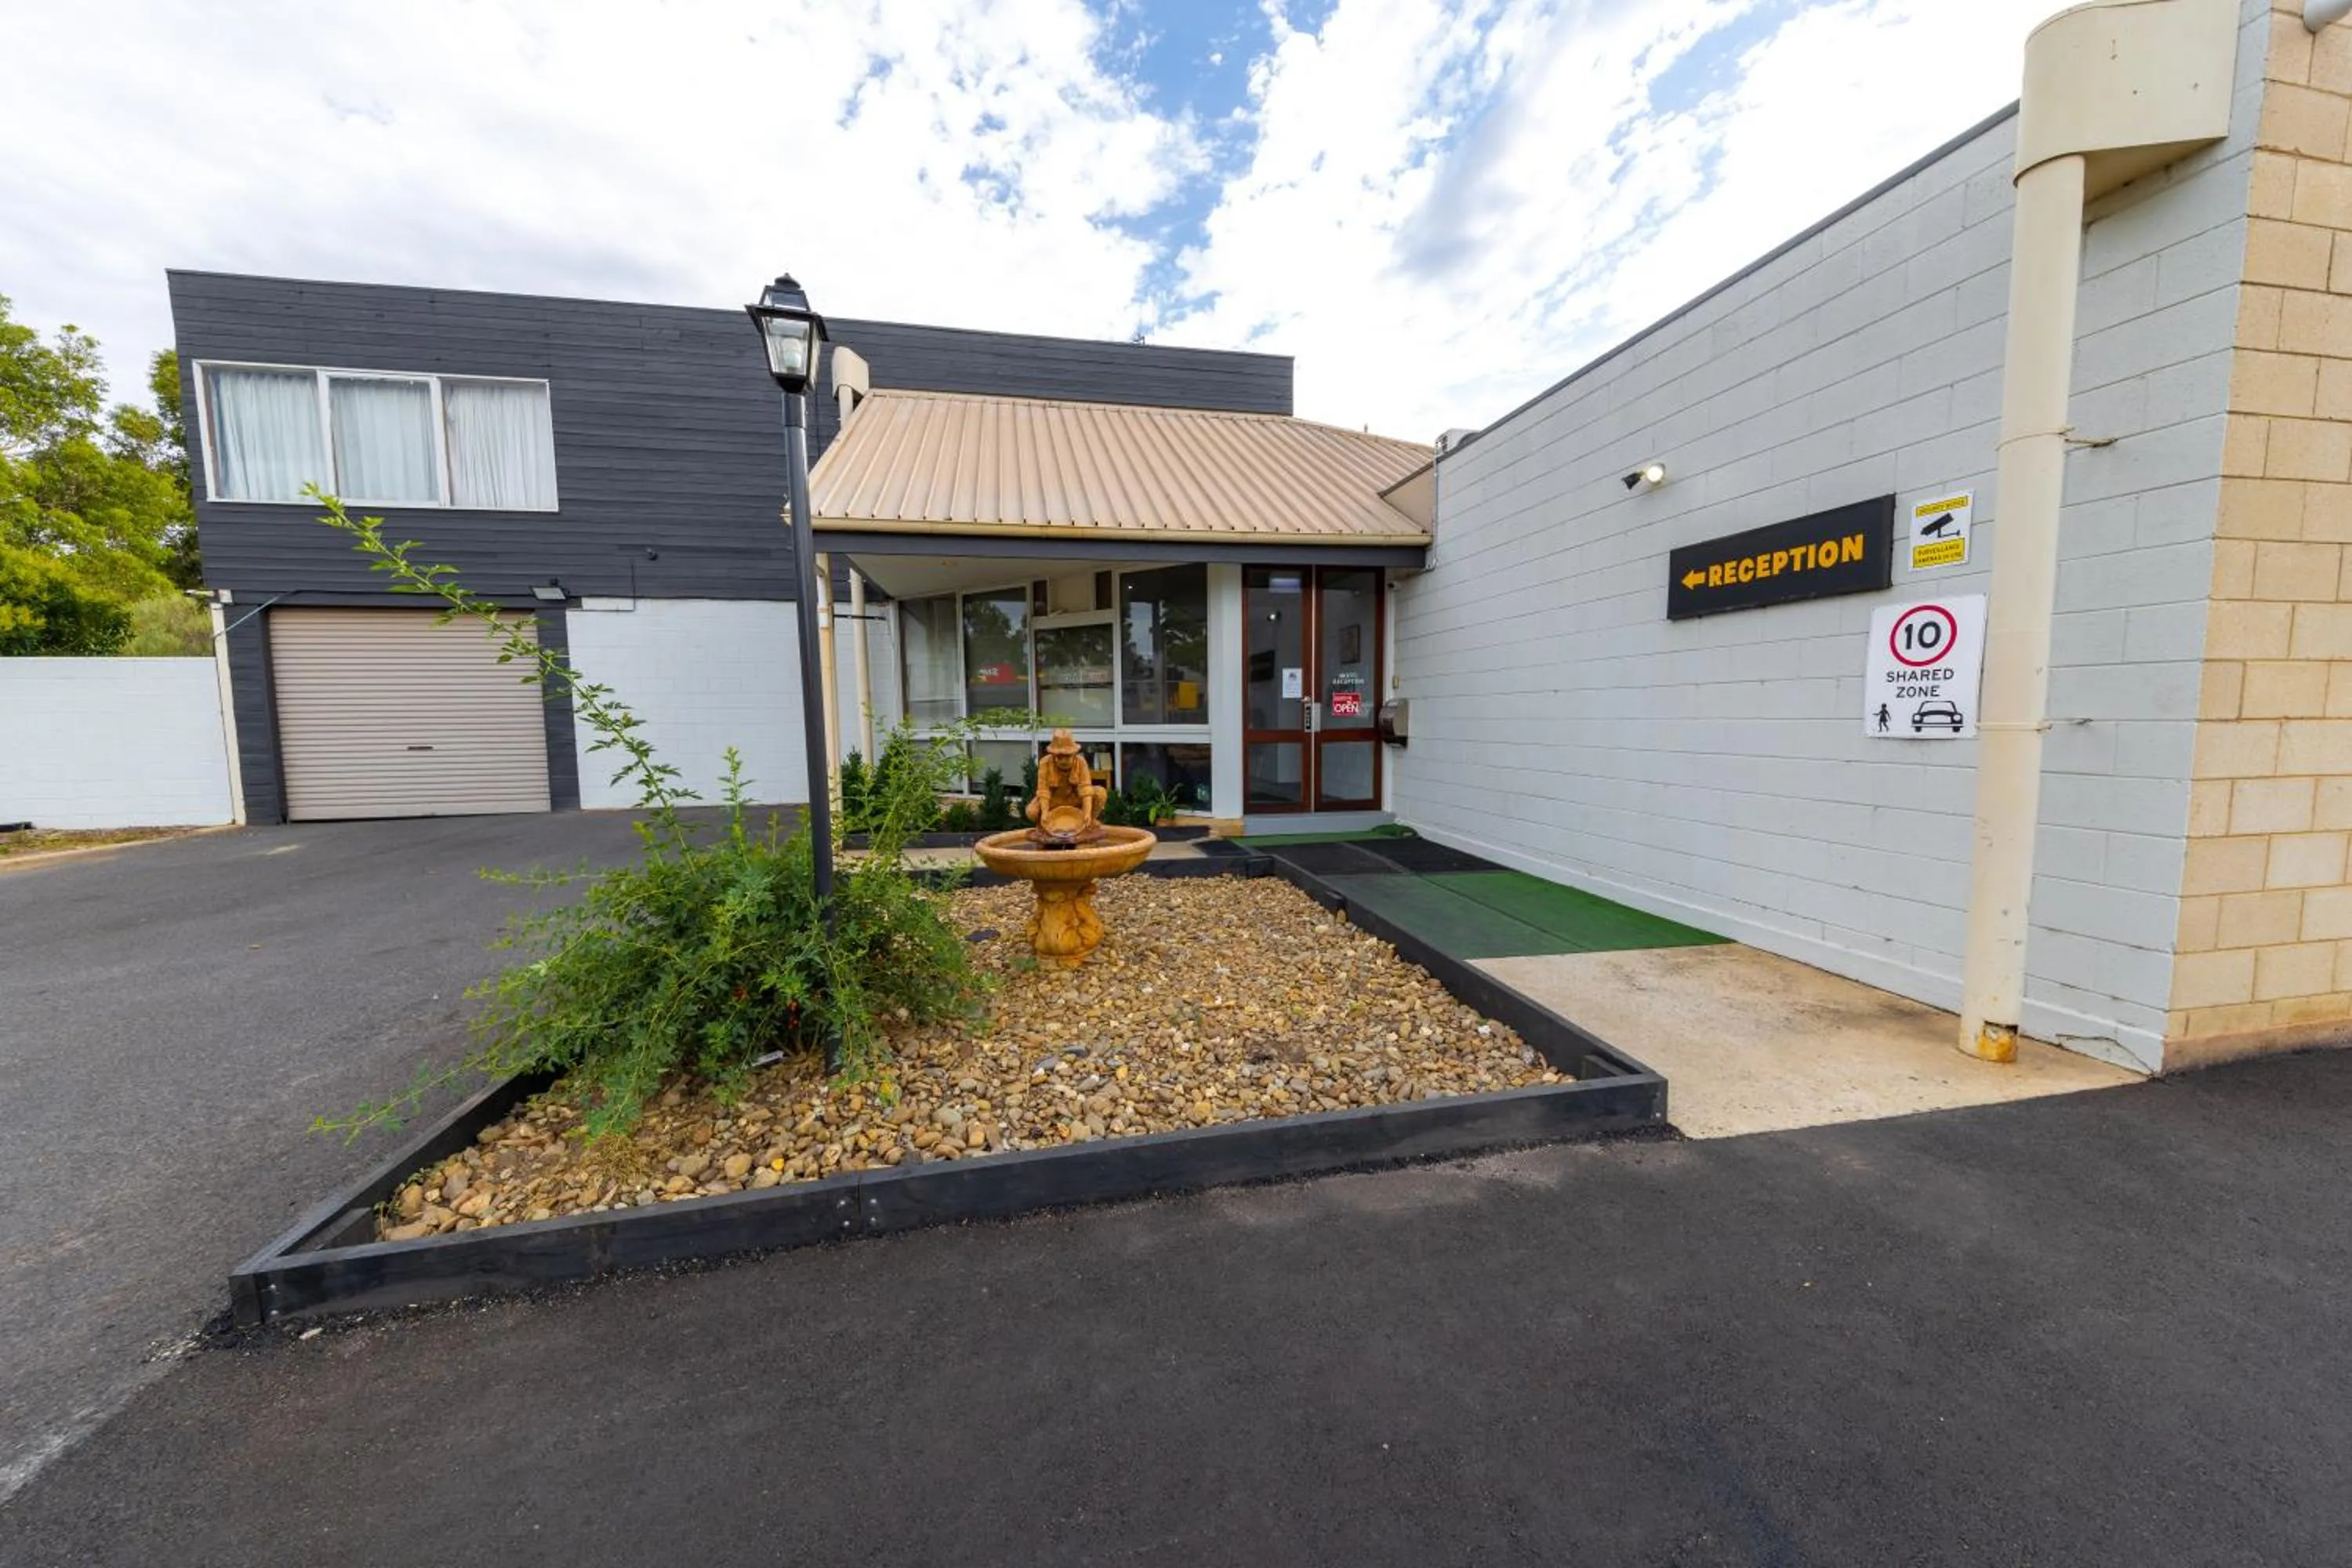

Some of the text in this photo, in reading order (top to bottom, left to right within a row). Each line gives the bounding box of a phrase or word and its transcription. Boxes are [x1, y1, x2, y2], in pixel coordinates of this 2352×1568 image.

[1708, 534, 1864, 587] RECEPTION
[1904, 621, 1941, 650] 10
[1886, 669, 1955, 683] SHARED
[1896, 685, 1940, 699] ZONE
[1334, 702, 1359, 713] OPEN
